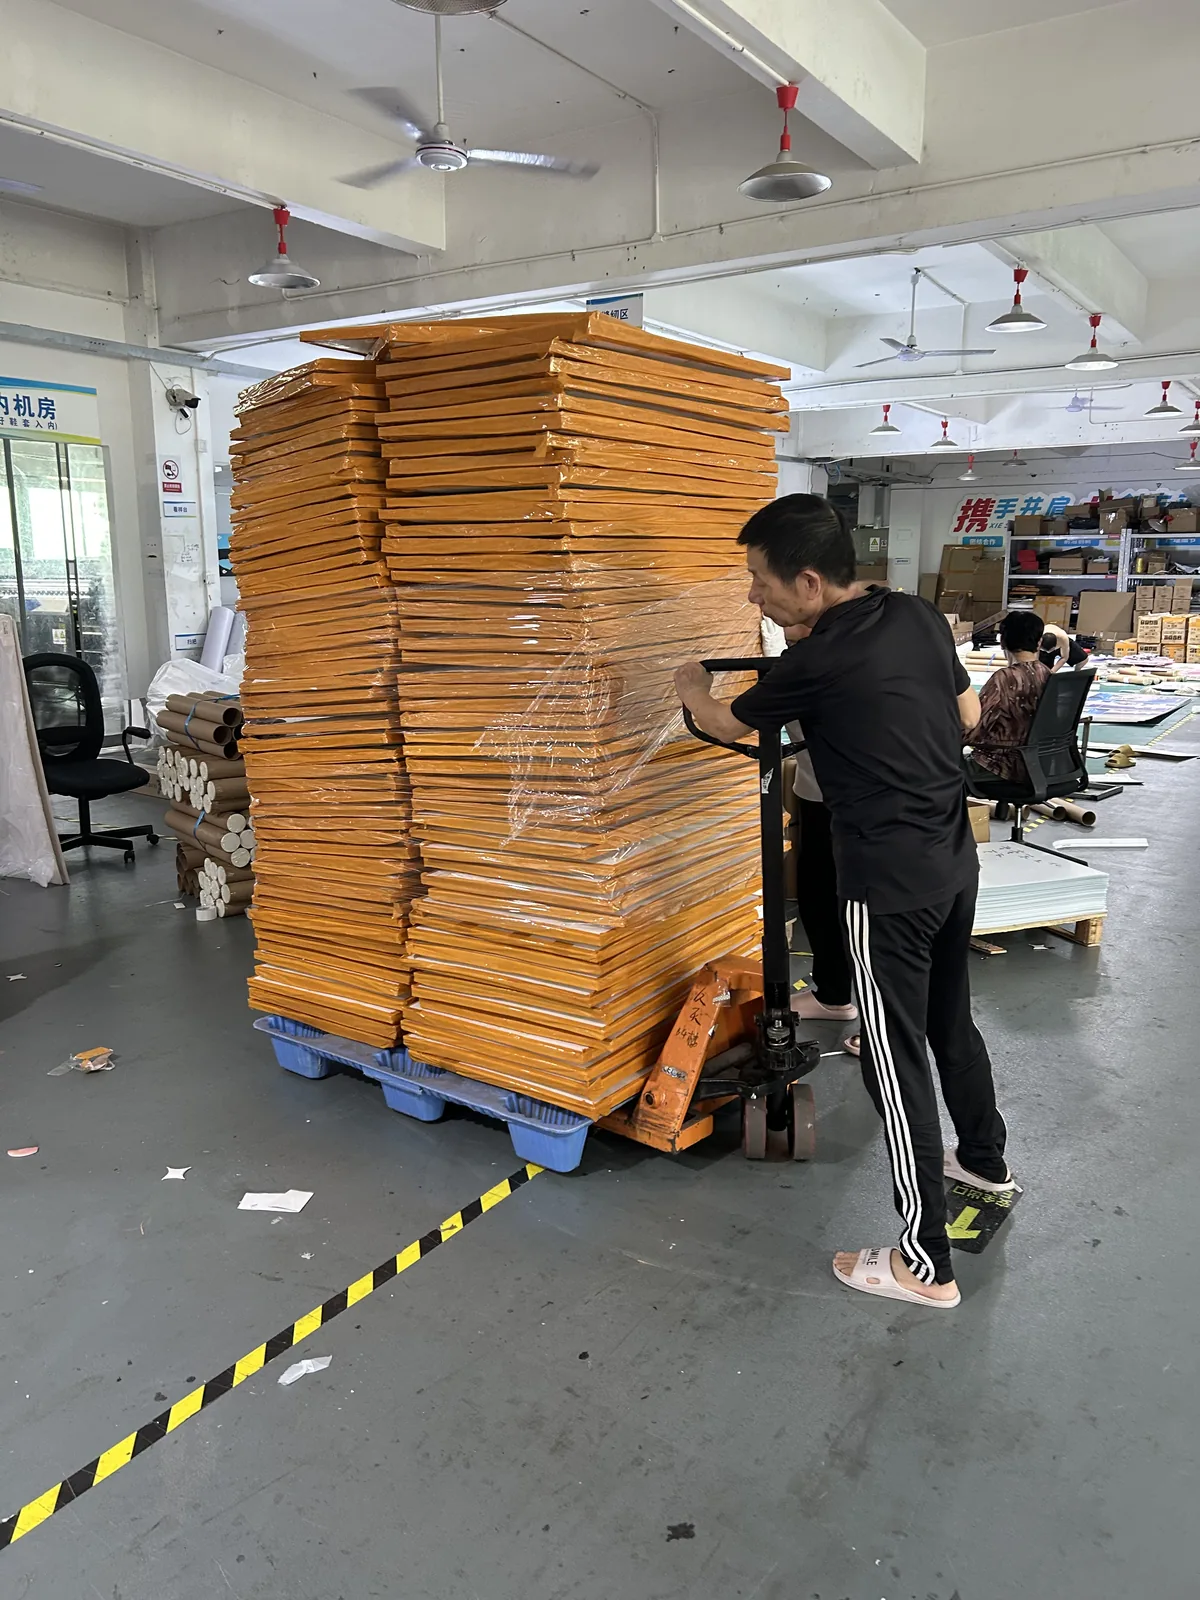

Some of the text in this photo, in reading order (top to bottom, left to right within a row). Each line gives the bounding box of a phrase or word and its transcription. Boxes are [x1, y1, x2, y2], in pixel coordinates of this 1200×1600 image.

[953, 496, 1071, 533] 携手并肩
[952, 1185, 1013, 1208] 安全出口
[866, 1247, 881, 1266] SMILE
